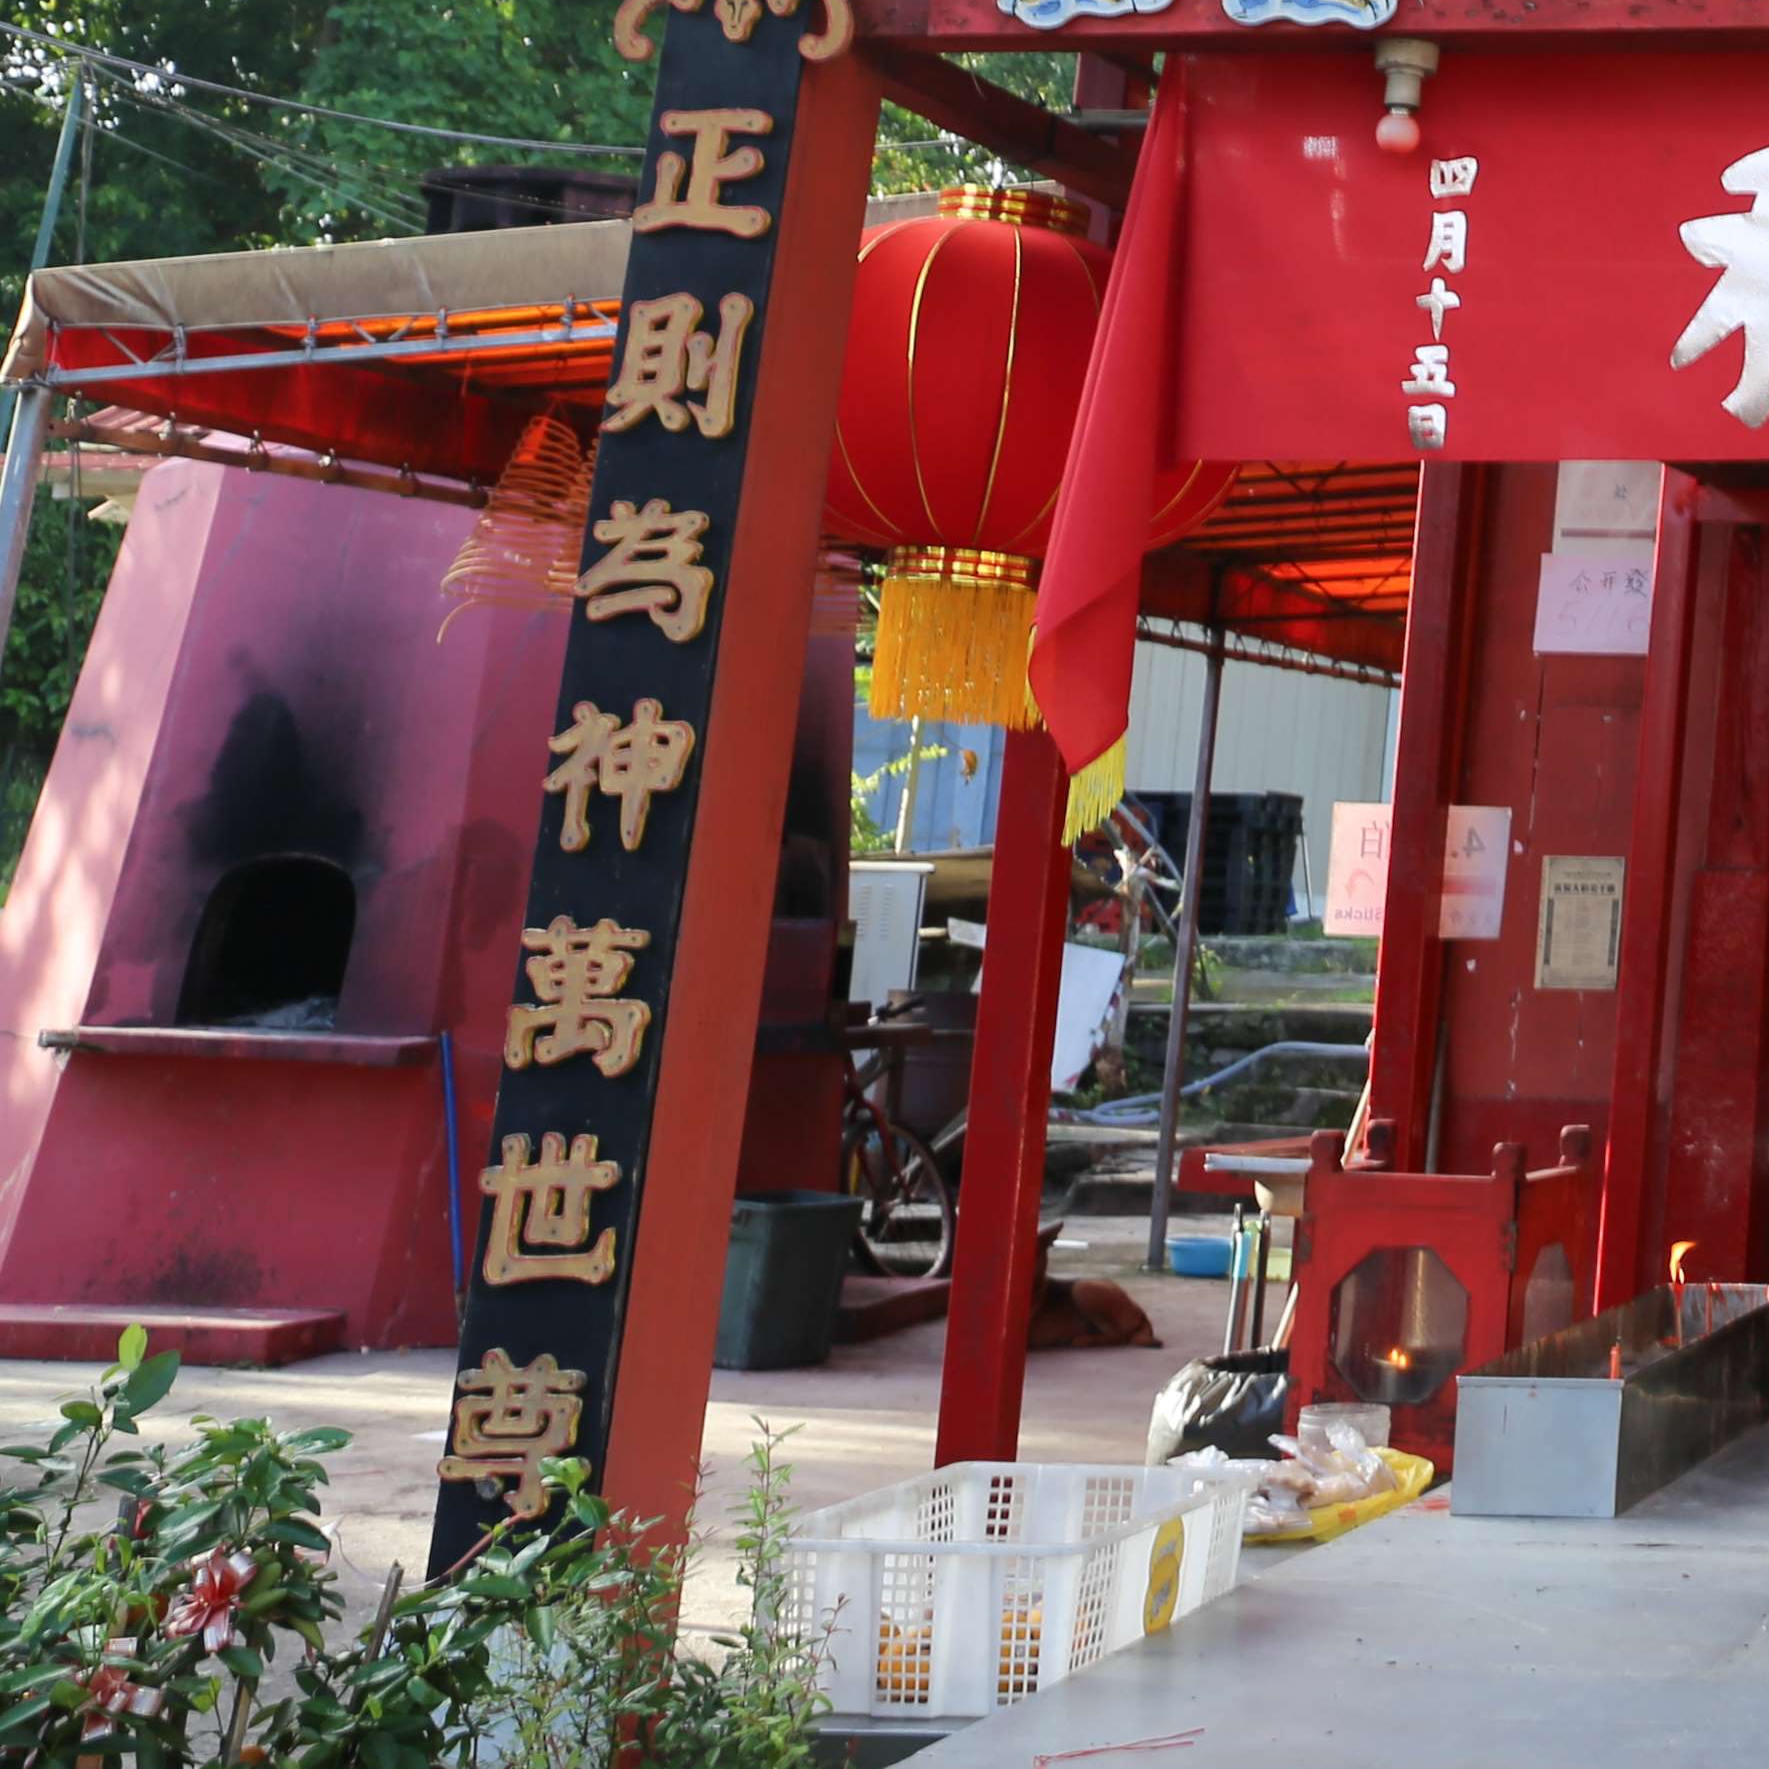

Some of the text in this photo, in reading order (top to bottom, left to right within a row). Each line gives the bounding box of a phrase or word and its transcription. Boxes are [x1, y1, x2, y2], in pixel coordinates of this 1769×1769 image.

[1401, 156, 1480, 450] 四月十五日
